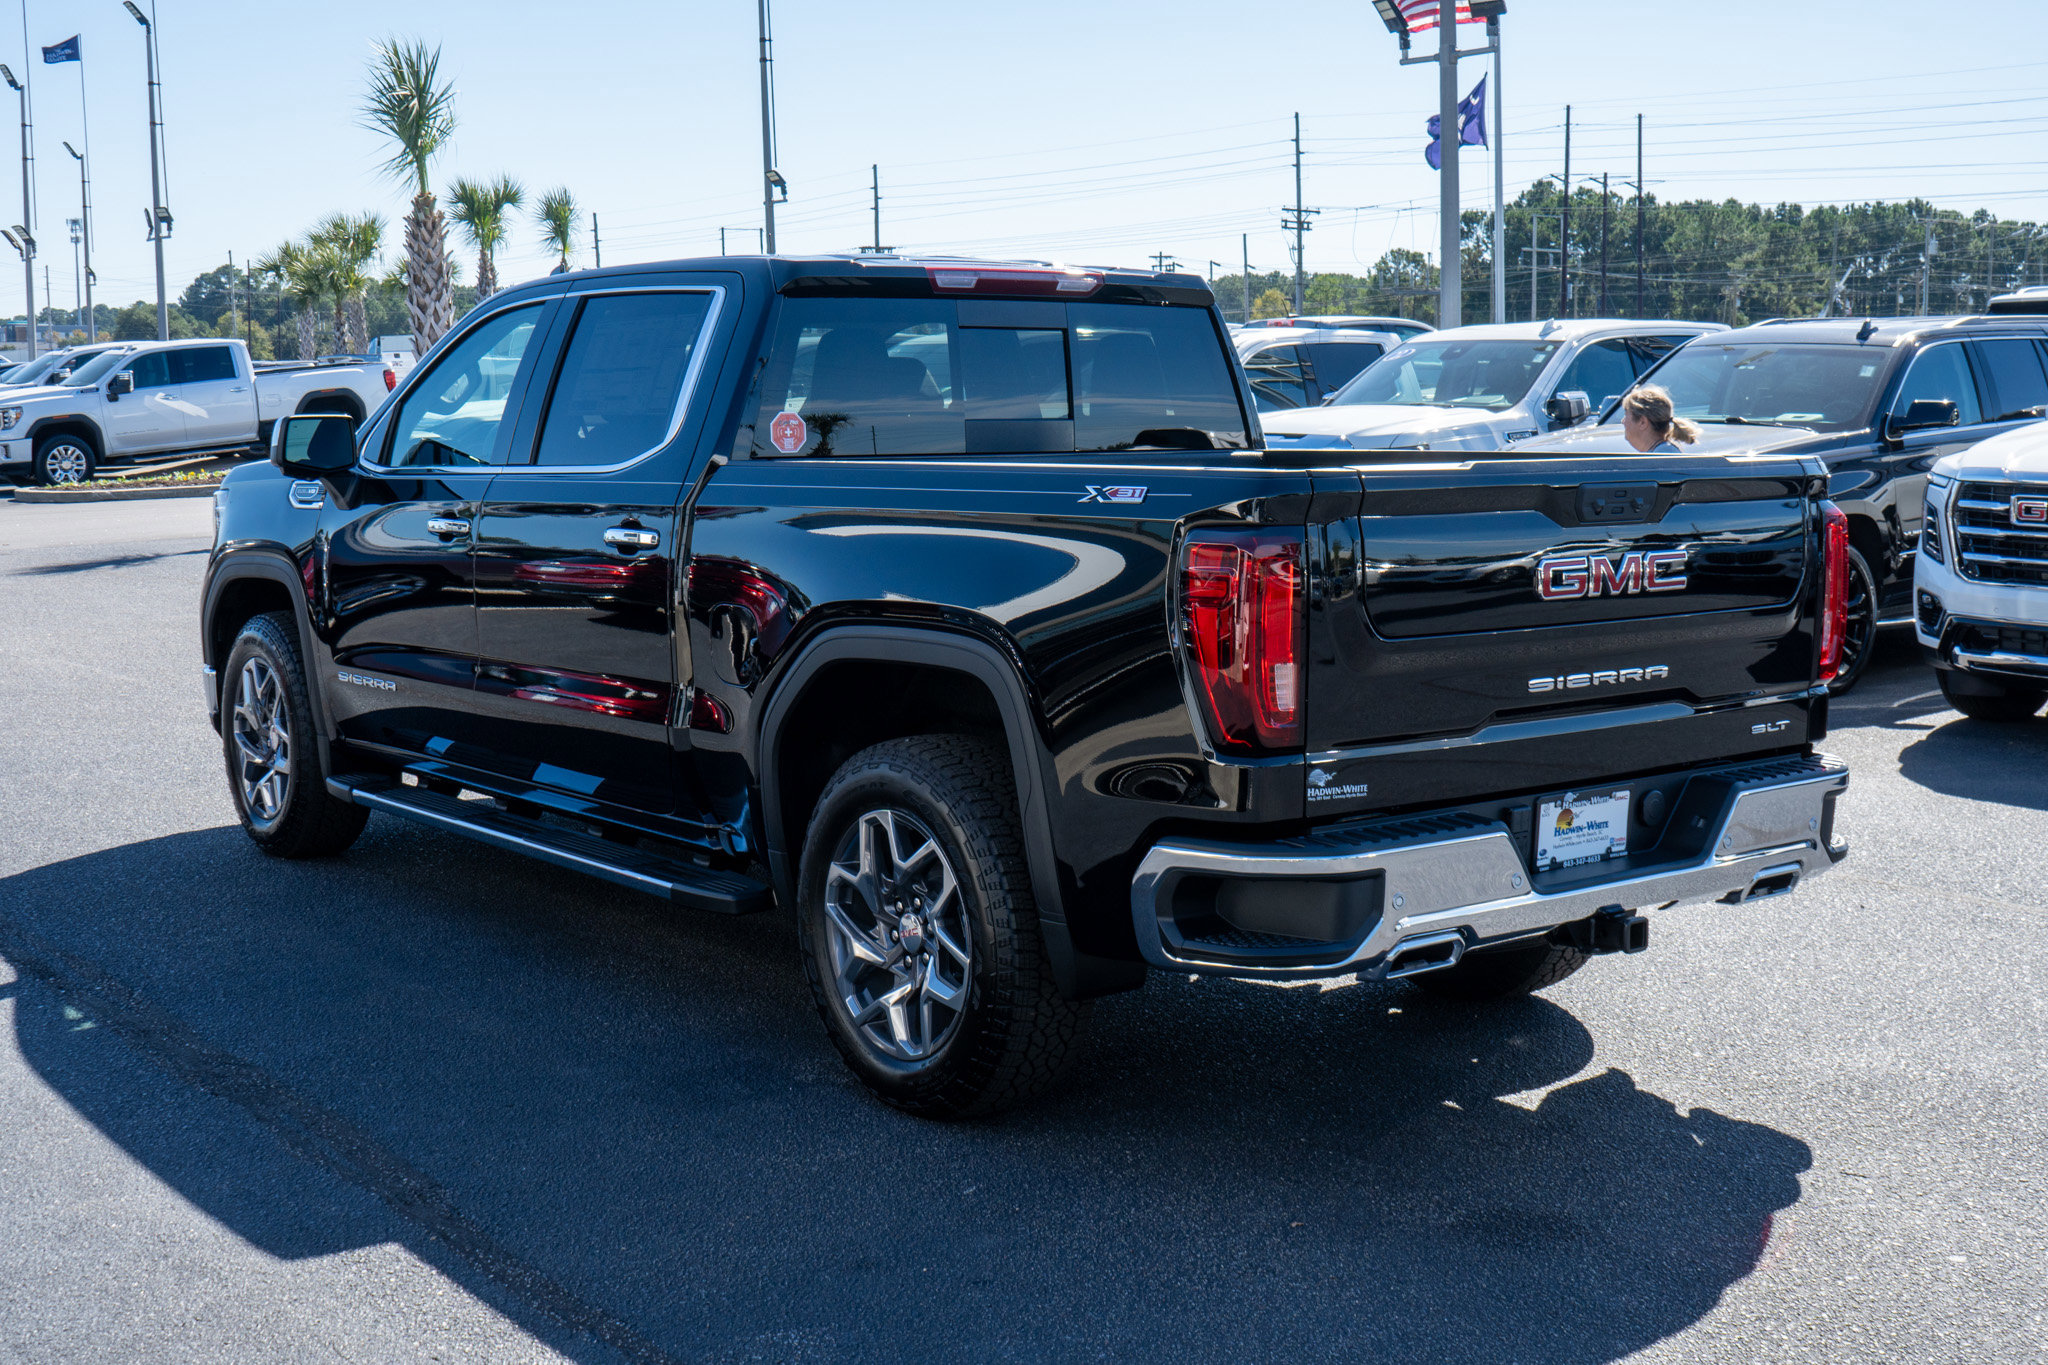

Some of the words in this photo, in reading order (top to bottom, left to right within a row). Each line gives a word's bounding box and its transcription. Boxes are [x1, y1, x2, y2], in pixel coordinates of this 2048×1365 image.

[1077, 485, 1148, 504] X31
[1535, 550, 1688, 600] GMC
[337, 671, 397, 692] SIERRA
[1527, 664, 1669, 693] SIERRA
[1751, 719, 1791, 735] SLT
[1307, 784, 1368, 797] HADWIN-WHITE
[1563, 796, 1610, 809] HADWIN-WHITE
[1554, 820, 1609, 837] HADWIN-WHITE
[1563, 855, 1600, 868] 843-347-4633
